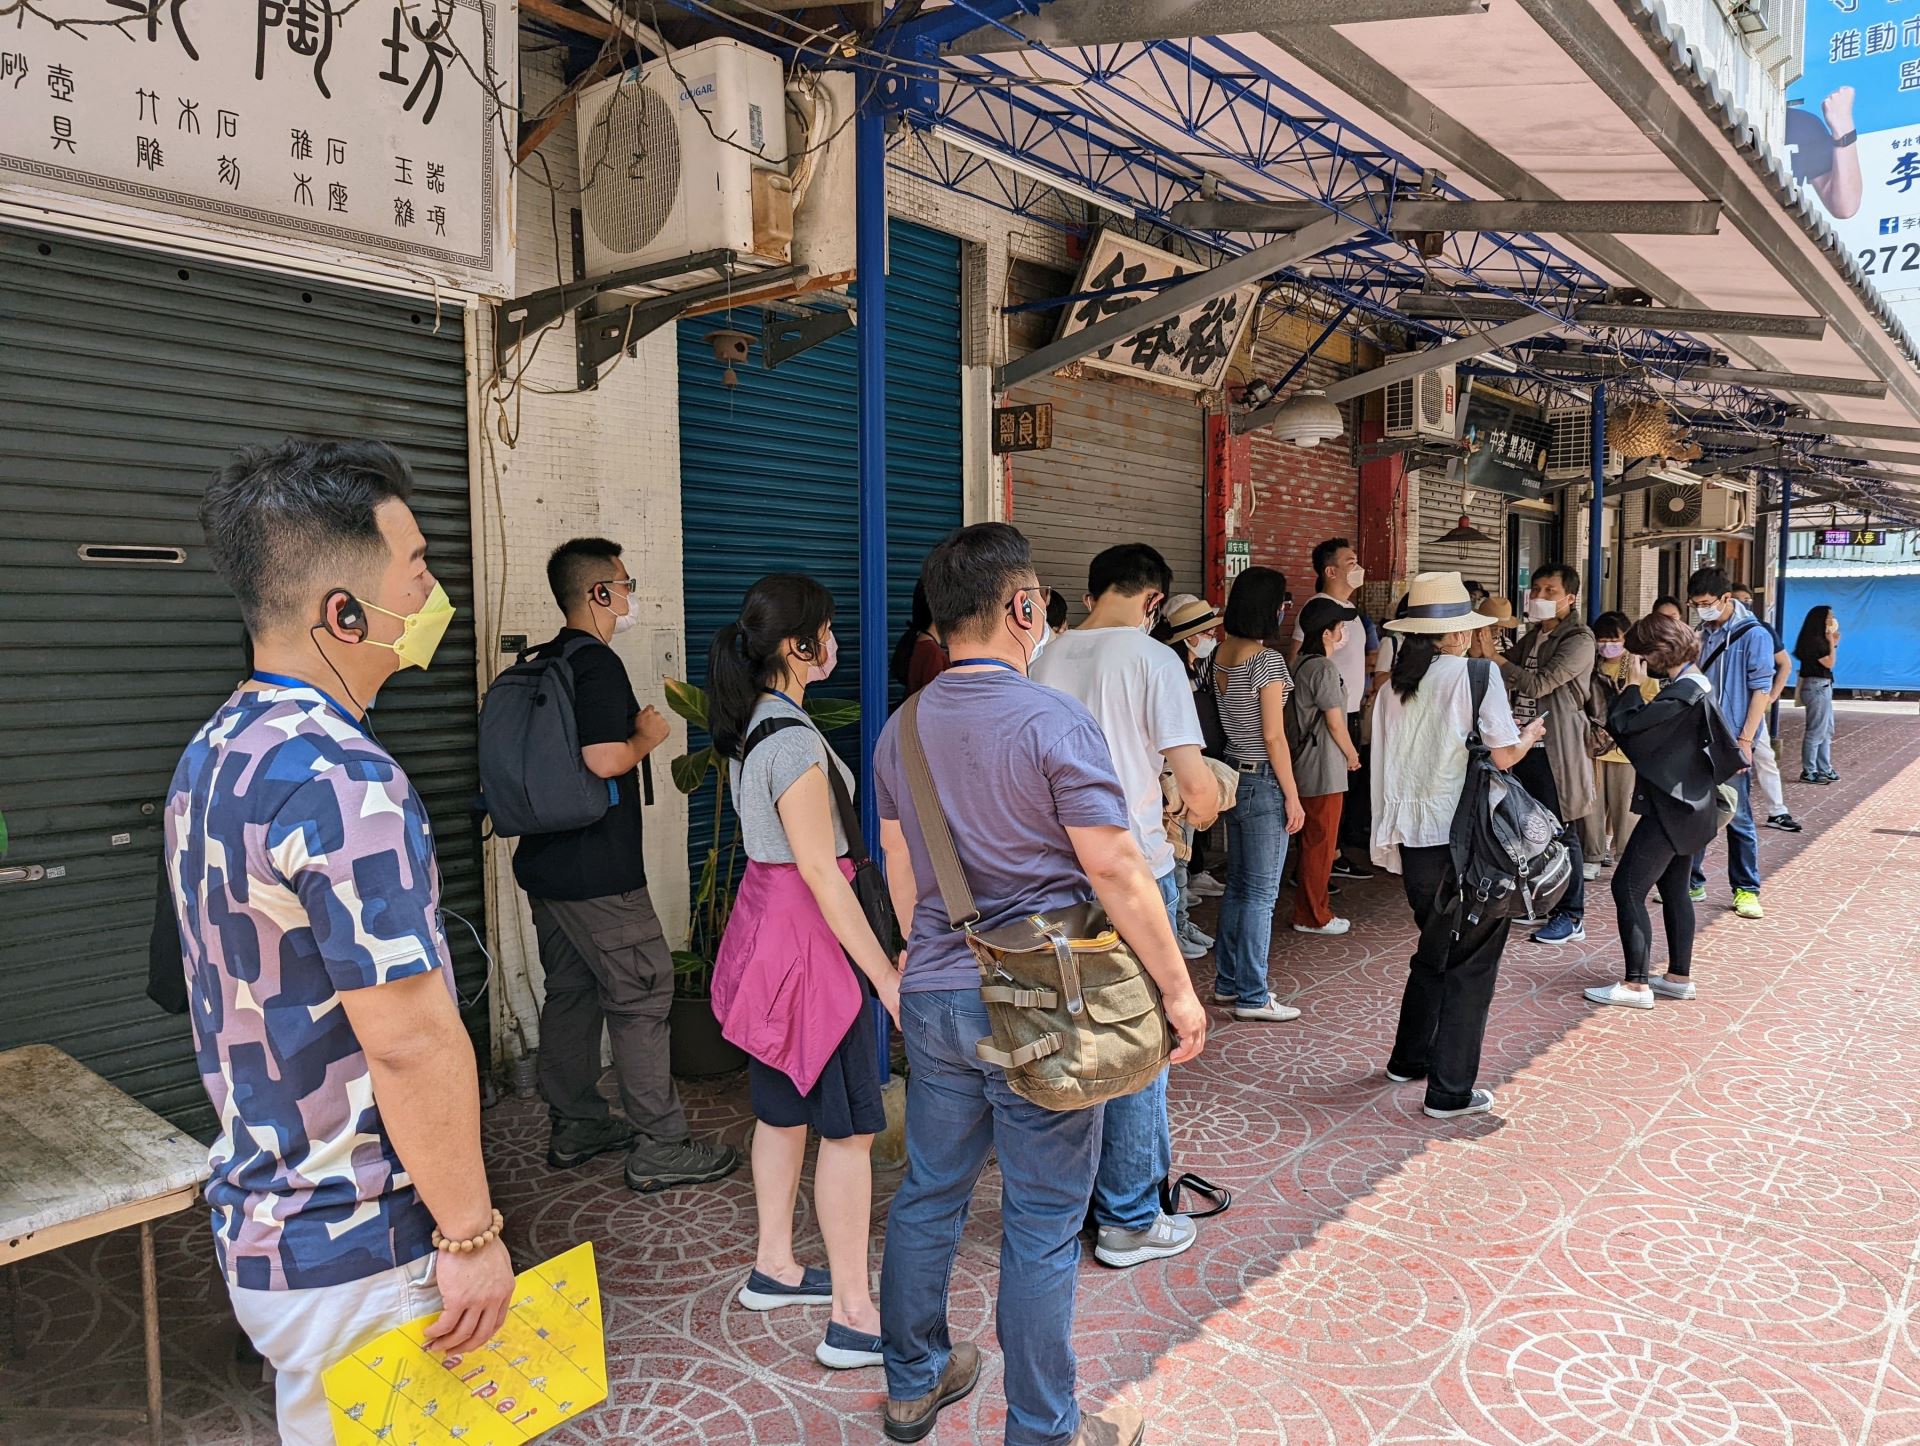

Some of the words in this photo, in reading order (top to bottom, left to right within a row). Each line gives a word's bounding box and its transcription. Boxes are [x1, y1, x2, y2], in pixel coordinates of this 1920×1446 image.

[106, 0, 454, 125] 陶坊
[680, 83, 713, 101] COUGAR
[1858, 243, 1920, 276] 272
[1231, 556, 1248, 575] 111
